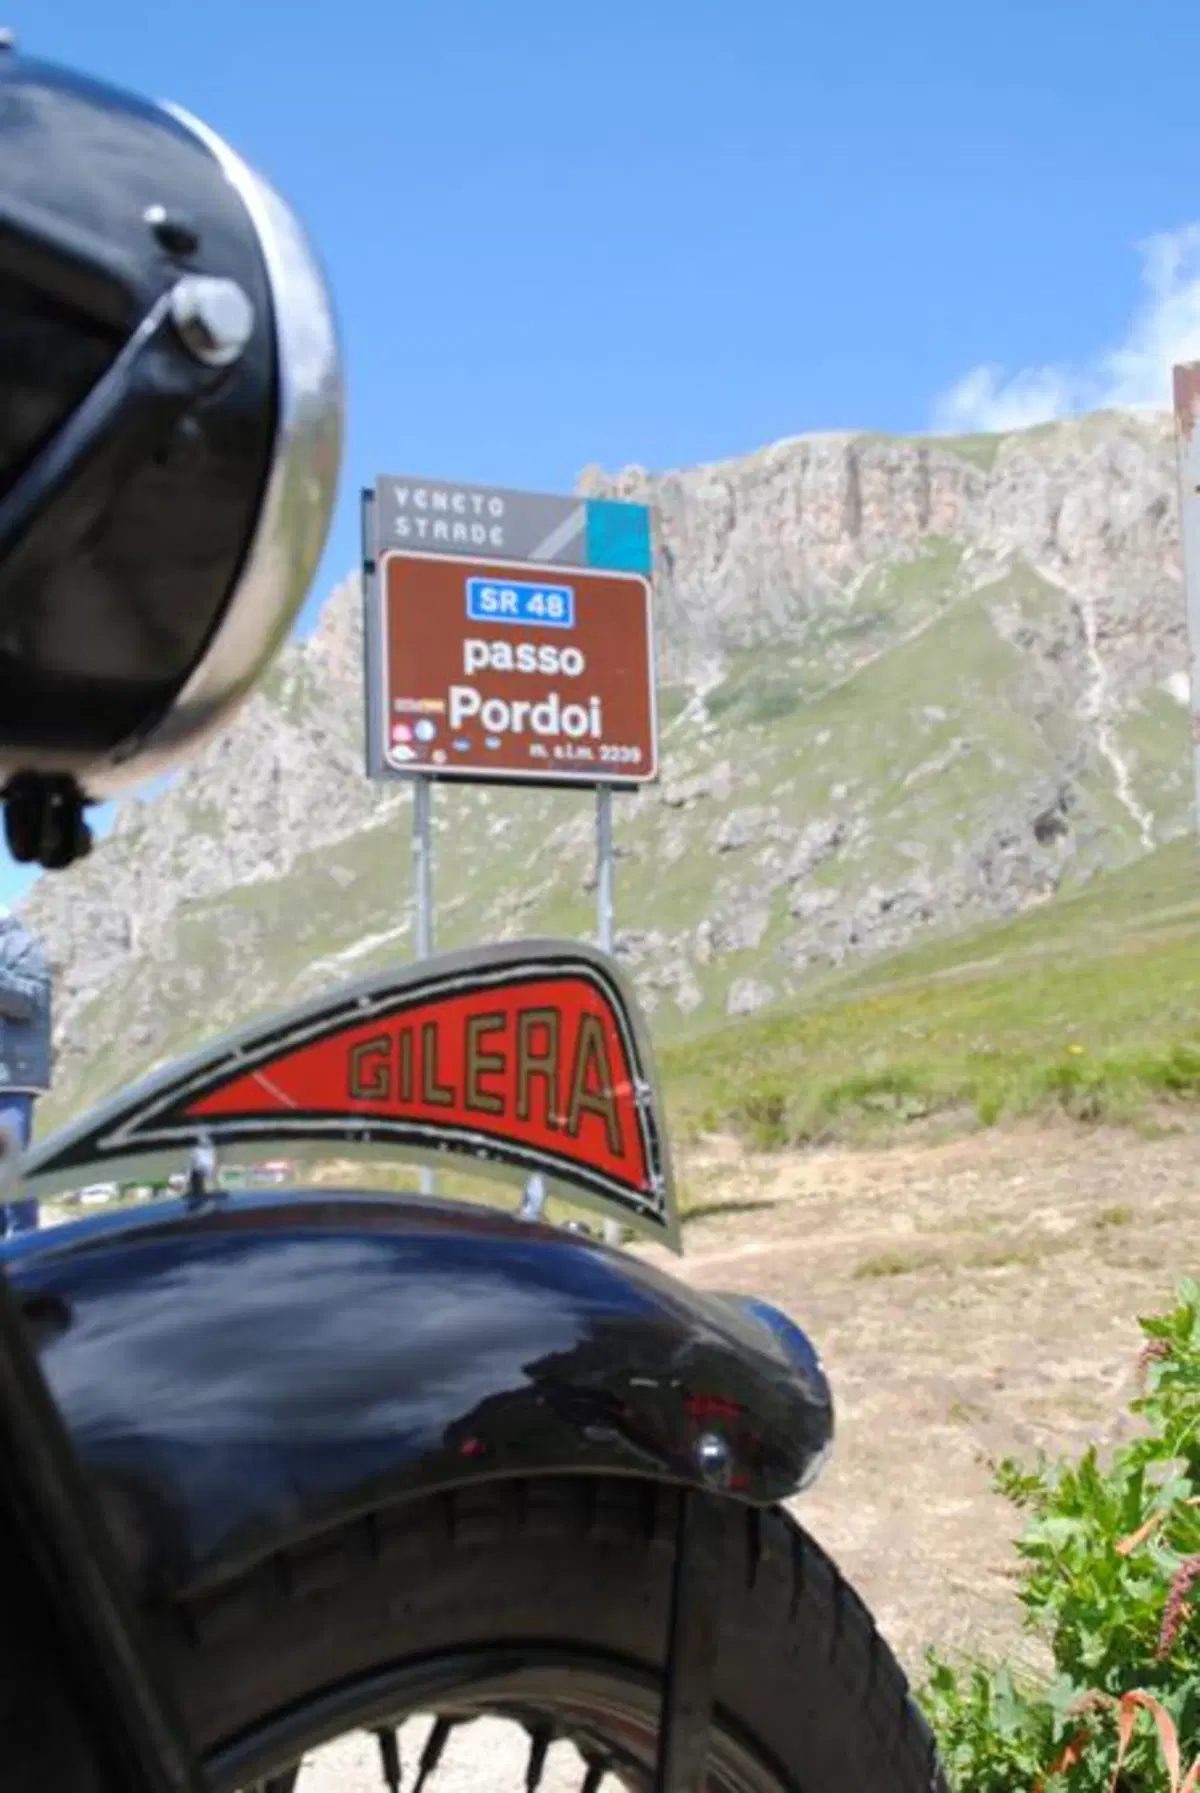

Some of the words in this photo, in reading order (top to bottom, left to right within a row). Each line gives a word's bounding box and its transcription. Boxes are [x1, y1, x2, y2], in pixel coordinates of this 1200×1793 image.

[394, 486, 505, 516] VENETO
[395, 517, 505, 546] STRADE
[480, 588, 518, 614] SR
[527, 593, 565, 618] 48
[463, 639, 585, 676] passo
[449, 685, 602, 738] Pordoi
[348, 1007, 625, 1157] GILERA
